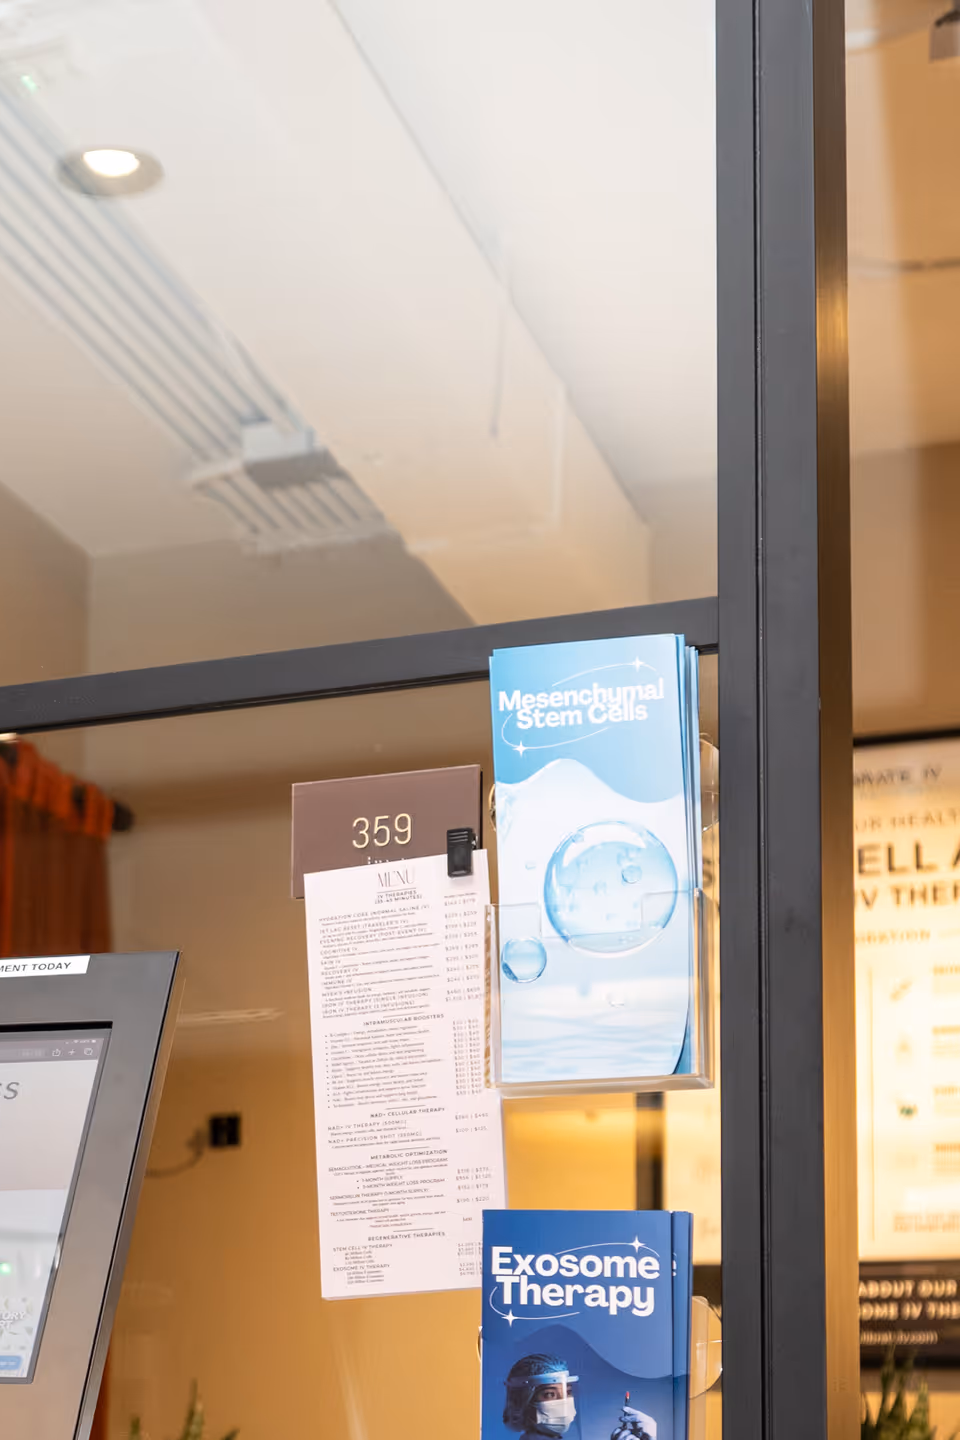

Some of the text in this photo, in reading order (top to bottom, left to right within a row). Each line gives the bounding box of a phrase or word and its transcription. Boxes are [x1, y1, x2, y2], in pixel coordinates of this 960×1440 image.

[516, 701, 648, 730] Stem Cells
[352, 813, 412, 849] 359
[377, 866, 416, 888] MENU
[32, 962, 71, 971] TODAY
[363, 1016, 412, 1026] INTRAMUSCULAR
[405, 1148, 447, 1156] OPTIMIZATION
[368, 1233, 410, 1241] REGENERATIVE
[491, 1246, 660, 1279] Exosome
[495, 1275, 655, 1317] Therapy
[858, 1301, 898, 1320] OME
